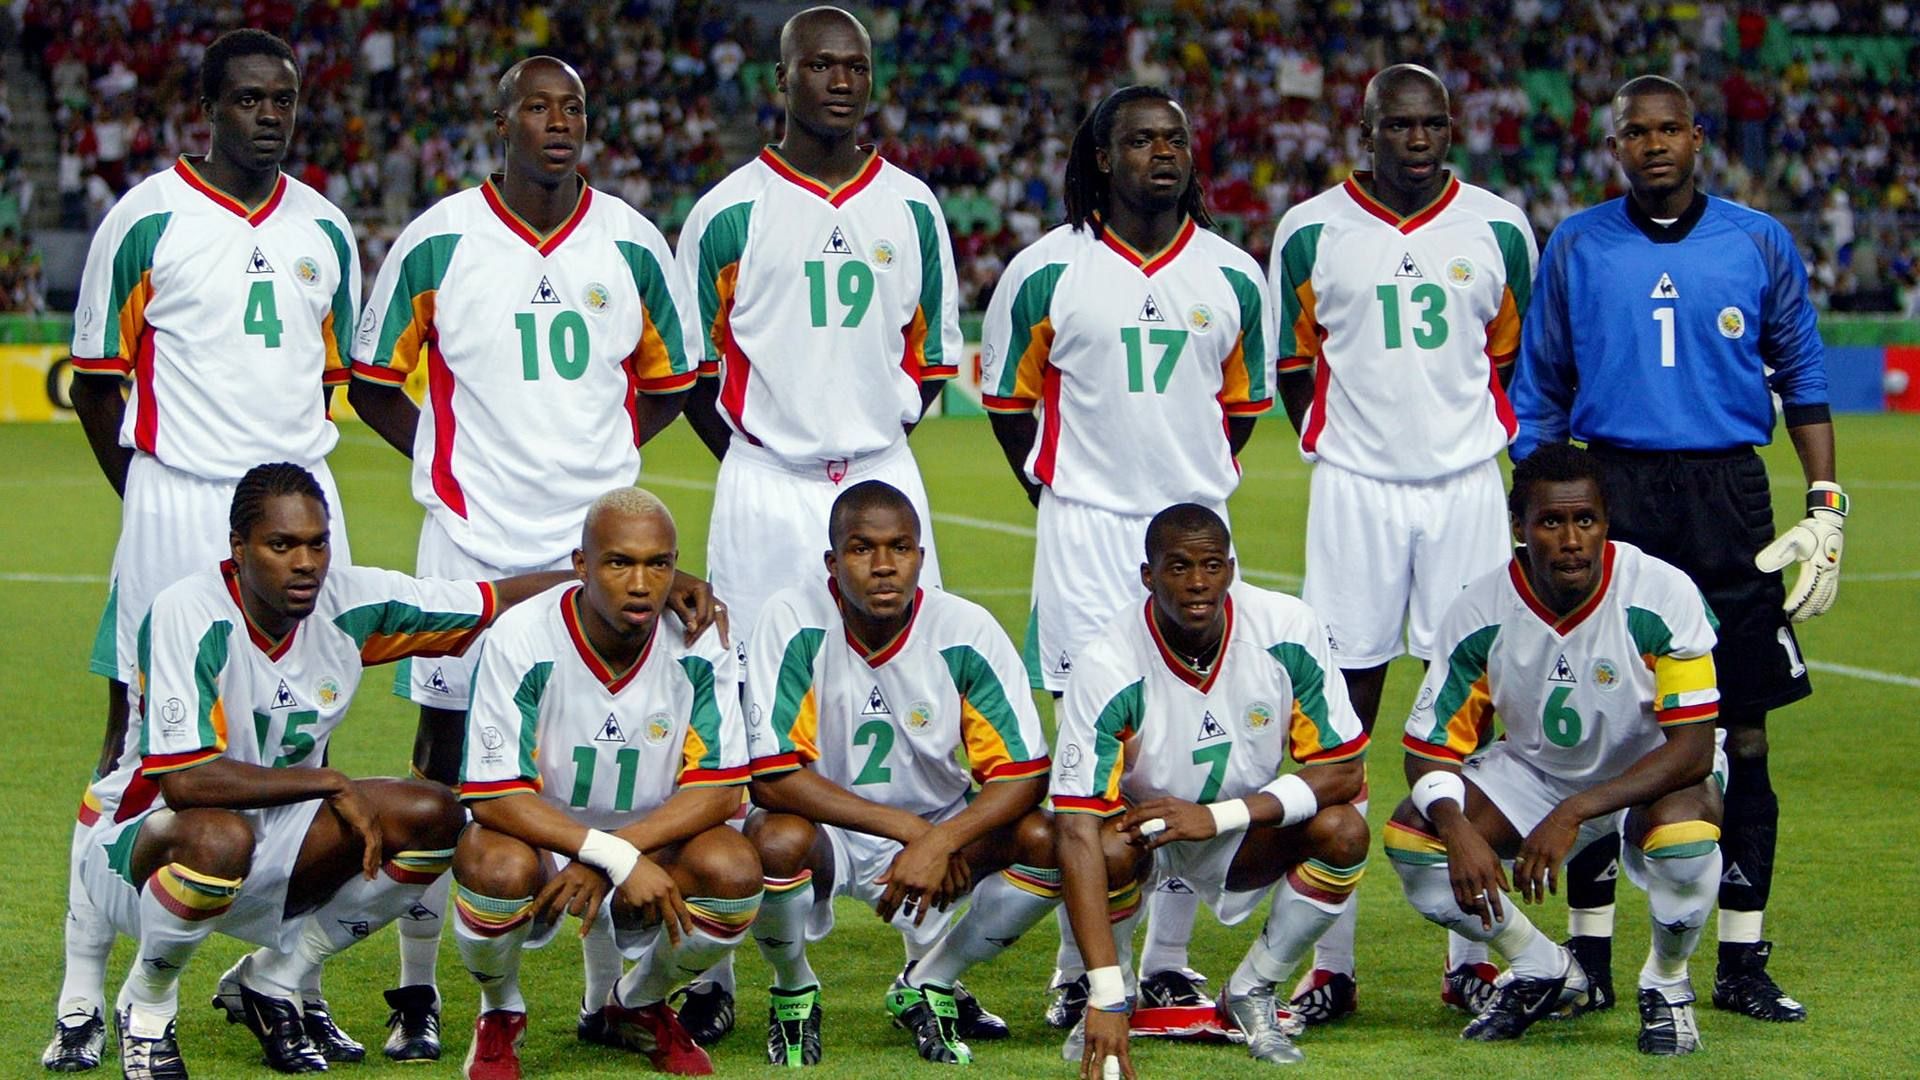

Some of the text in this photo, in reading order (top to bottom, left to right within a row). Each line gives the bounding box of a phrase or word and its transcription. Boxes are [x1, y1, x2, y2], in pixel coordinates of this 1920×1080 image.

[244, 281, 283, 348] 4
[804, 260, 874, 328] 19
[1376, 283, 1449, 349] 13
[515, 310, 590, 381] 10
[1120, 327, 1188, 393] 17
[1653, 307, 1675, 367] 1
[1777, 626, 1805, 678] 1
[1542, 686, 1582, 748] 6
[570, 746, 640, 811] 11
[854, 719, 895, 786] 2
[1192, 741, 1232, 805] 7
